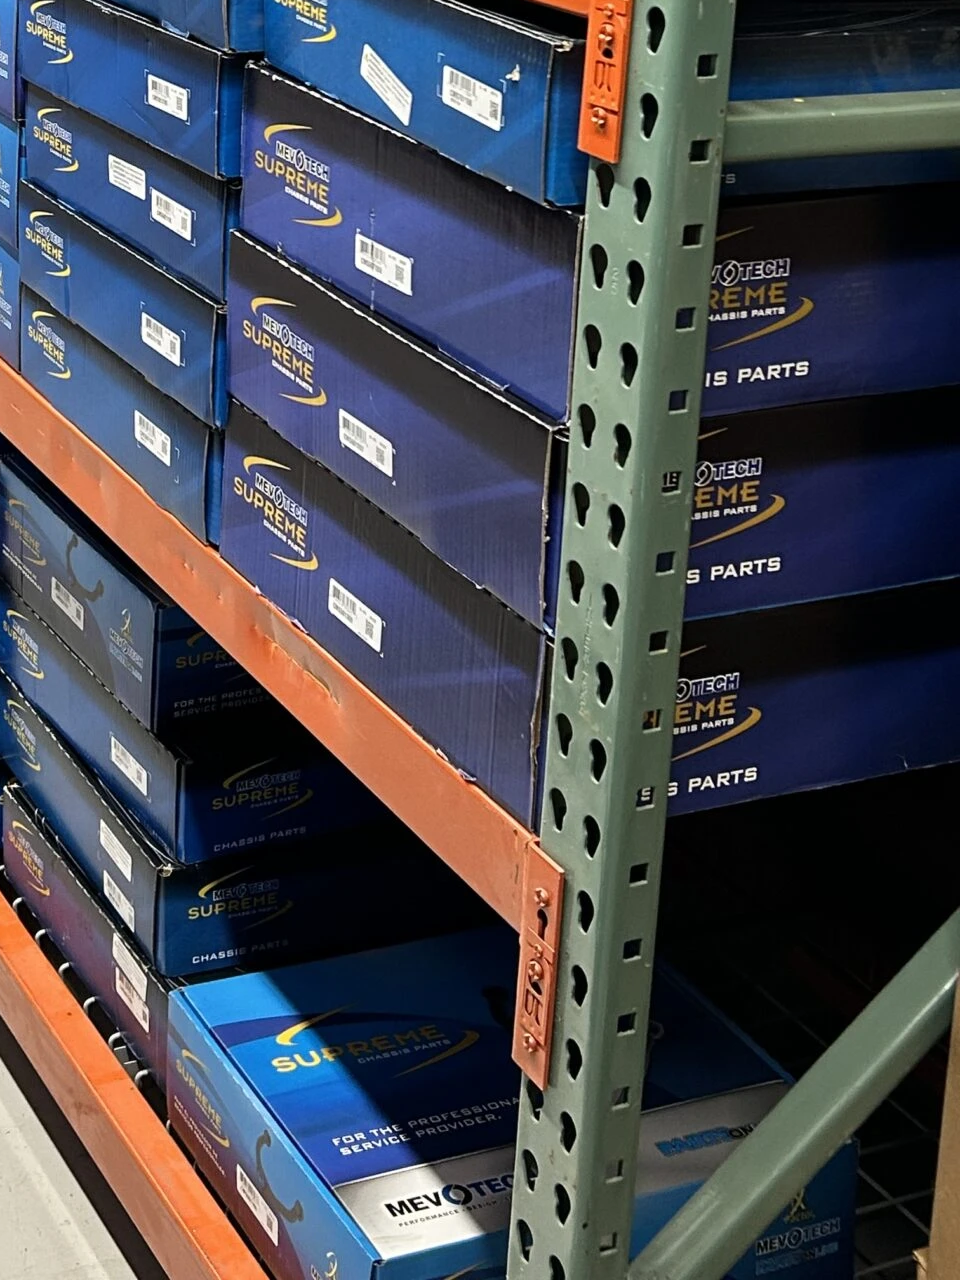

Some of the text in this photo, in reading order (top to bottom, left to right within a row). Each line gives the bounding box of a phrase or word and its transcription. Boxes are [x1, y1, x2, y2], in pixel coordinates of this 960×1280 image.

[26, 20, 66, 48] SUPREME
[33, 126, 72, 157] SUPREME
[275, 141, 330, 183] MEVOTECH
[255, 150, 329, 204] SUPREME
[285, 186, 328, 215] CHASSIS PARTS
[25, 227, 64, 263] SUPREME
[751, 307, 785, 317] PARTS
[28, 325, 65, 364] SUPREME
[243, 319, 313, 382] SUPREME
[262, 313, 314, 360] MEVOTECH
[271, 359, 313, 394] CHASSIS PARTS
[737, 361, 809, 383] PARTS
[234, 476, 307, 548] SUPREME
[255, 472, 308, 526] MEVOTECH
[724, 505, 758, 516] PARTS
[4, 510, 41, 551] SUPREME
[263, 518, 305, 557] CHASSIS PARTS
[710, 557, 781, 581] PARTS
[3, 620, 39, 666] SUPREME
[174, 693, 218, 709] FOR THE
[3, 708, 37, 757] SUPREME
[701, 718, 735, 730] PARTS
[236, 769, 301, 791] MEVOTECH
[688, 767, 758, 793] PARTS
[212, 782, 300, 811] SUPREME
[8, 826, 43, 878] SUPREME
[214, 826, 307, 852] CHASSIS PARTS
[212, 879, 279, 901] MEVOTECH
[188, 893, 279, 919] SUPREME
[192, 940, 290, 964] CHASSIS PARTS
[271, 1023, 445, 1073] SUPREME
[357, 1038, 451, 1064] CHASSIS PARTS
[175, 1058, 223, 1128] SUPREME
[331, 1132, 367, 1147] FOR
[373, 1124, 402, 1138] THE
[339, 1133, 409, 1156] SERVICE
[398, 1209, 459, 1228] PERFORMANCE
[755, 1216, 840, 1256] MEVOTECH
